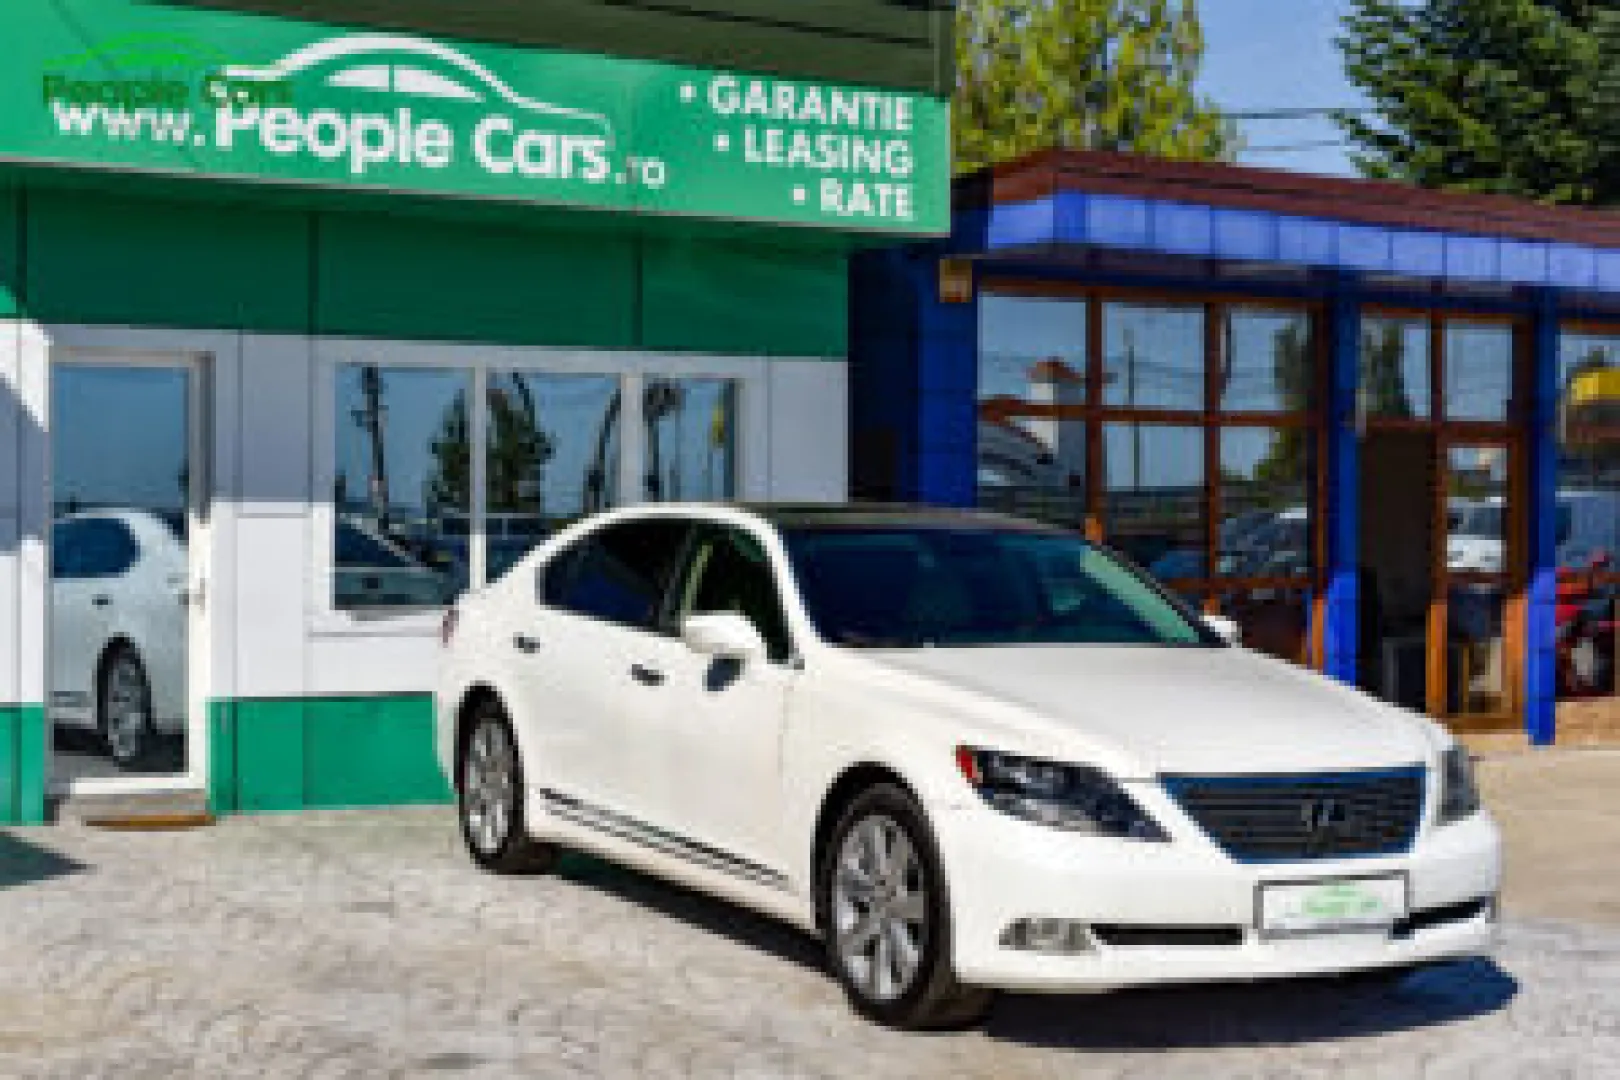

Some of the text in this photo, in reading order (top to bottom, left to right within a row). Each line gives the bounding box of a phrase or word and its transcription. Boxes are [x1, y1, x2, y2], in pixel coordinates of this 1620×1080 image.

[709, 76, 913, 131] GARANTIE
[744, 127, 914, 177] LEASING
[820, 178, 914, 220] RATE
